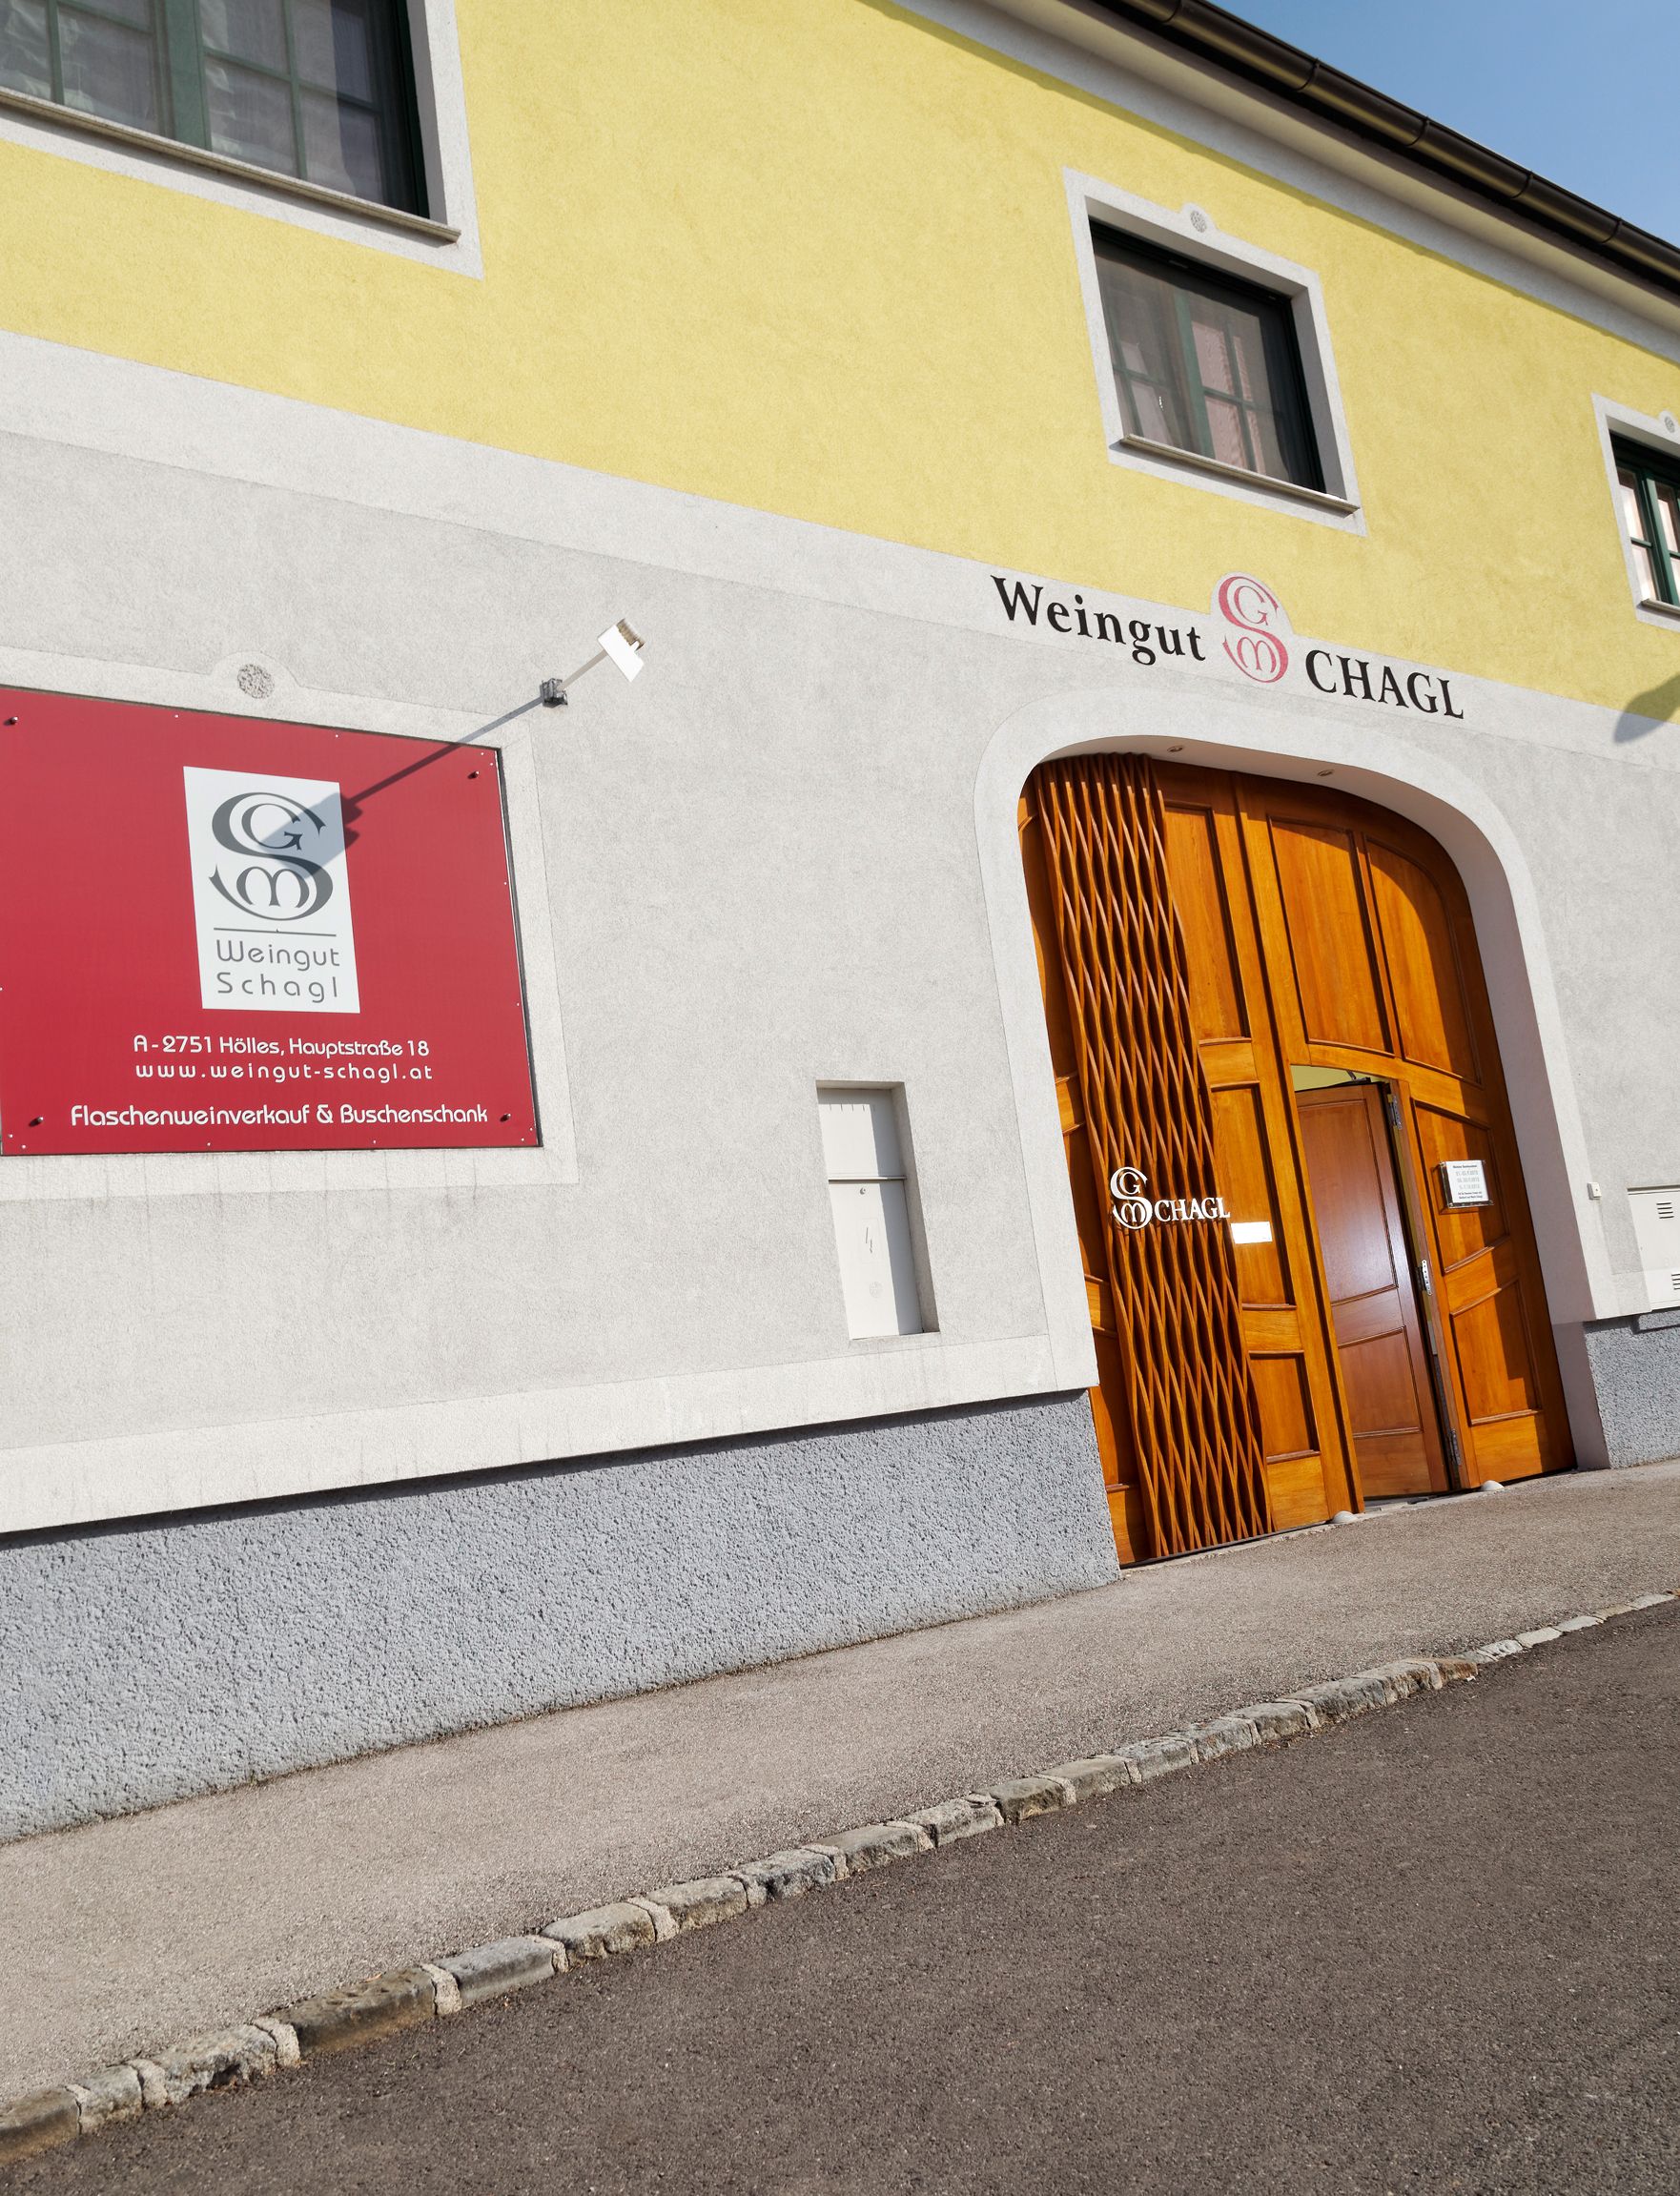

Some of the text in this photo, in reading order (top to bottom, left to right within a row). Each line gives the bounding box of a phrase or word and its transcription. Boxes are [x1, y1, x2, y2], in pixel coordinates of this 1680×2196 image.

[990, 574, 1206, 666] Weingut
[216, 939, 340, 971] Weingut
[216, 972, 338, 1003] Schagl
[219, 1036, 285, 1057] Hölles,
[289, 1037, 403, 1059] Hauptstraße
[407, 1039, 430, 1057] 18
[135, 1062, 433, 1084] www.weingut-schagl.at
[71, 1103, 488, 1127] Flaschenweinverkauf & Buschenschank
